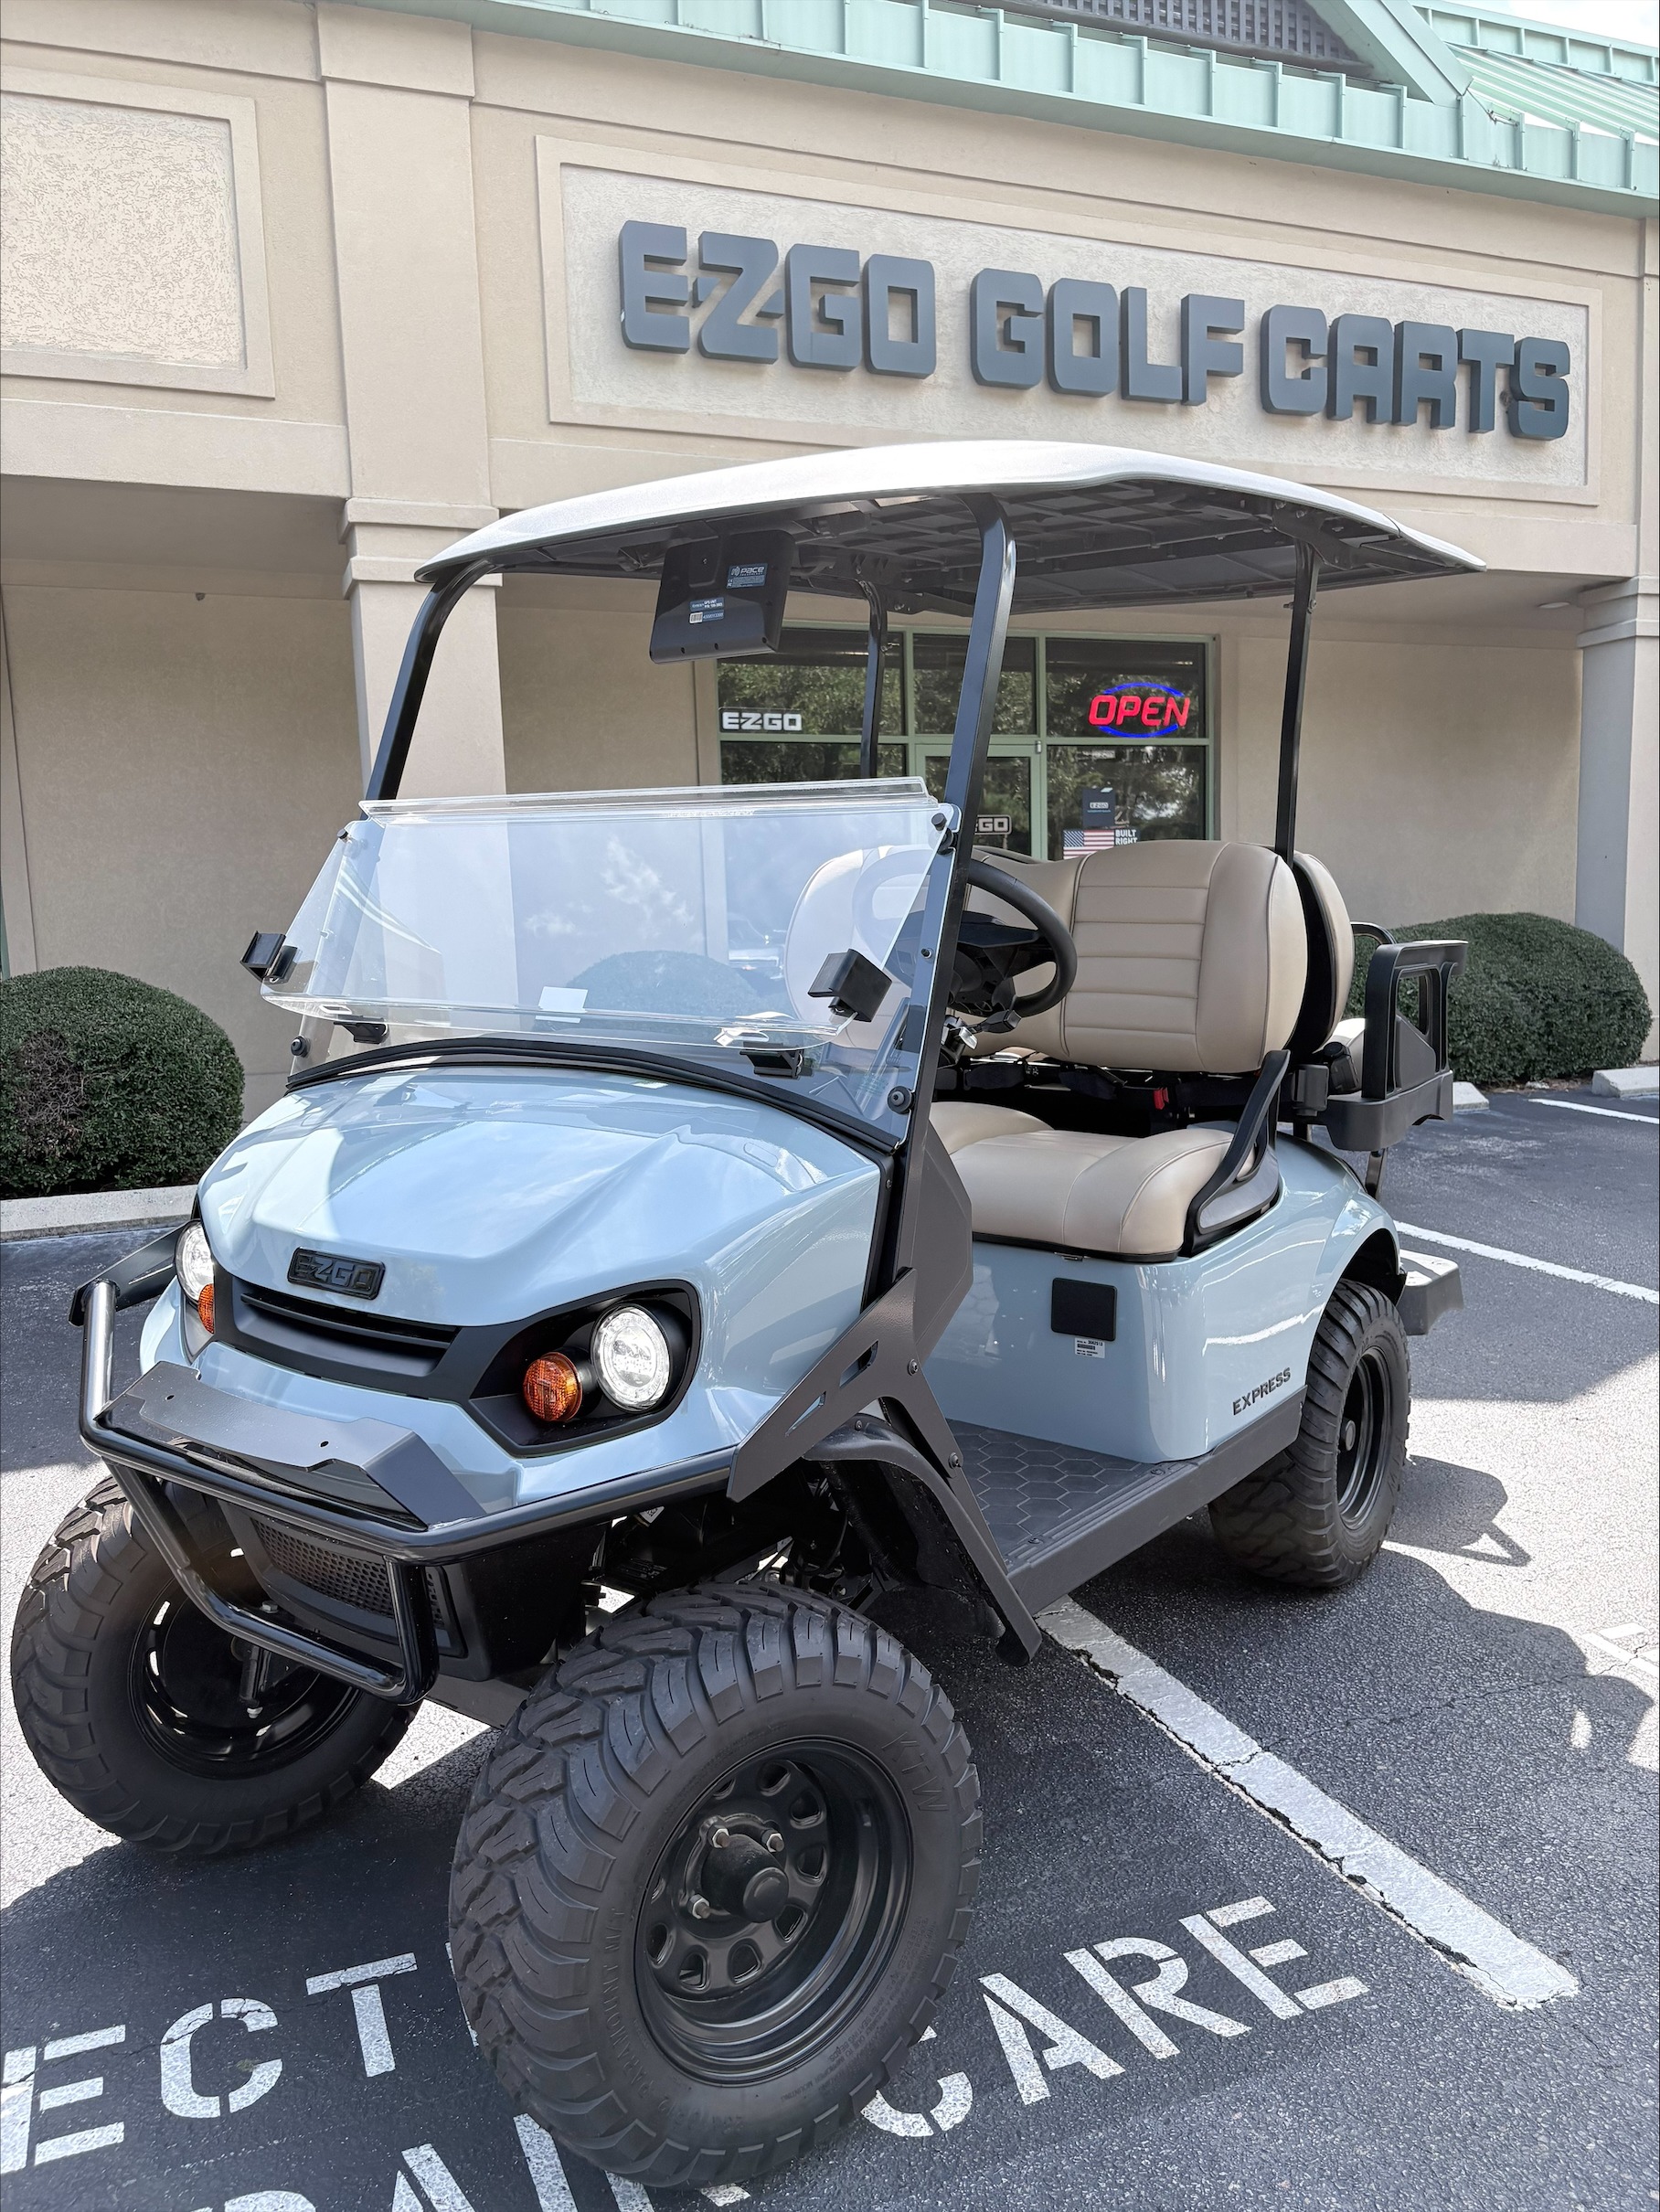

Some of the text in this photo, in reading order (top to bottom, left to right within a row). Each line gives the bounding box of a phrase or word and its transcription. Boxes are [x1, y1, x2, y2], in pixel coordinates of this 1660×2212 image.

[619, 220, 1570, 441] EZGO GOLF CARTS
[722, 711, 802, 731] EZGO
[1089, 695, 1190, 726] OPEN
[1115, 829, 1136, 837] BUILT
[1115, 837, 1138, 845] RIGHT
[293, 1252, 380, 1295] EZGO
[1233, 1367, 1292, 1417] EXPRESS
